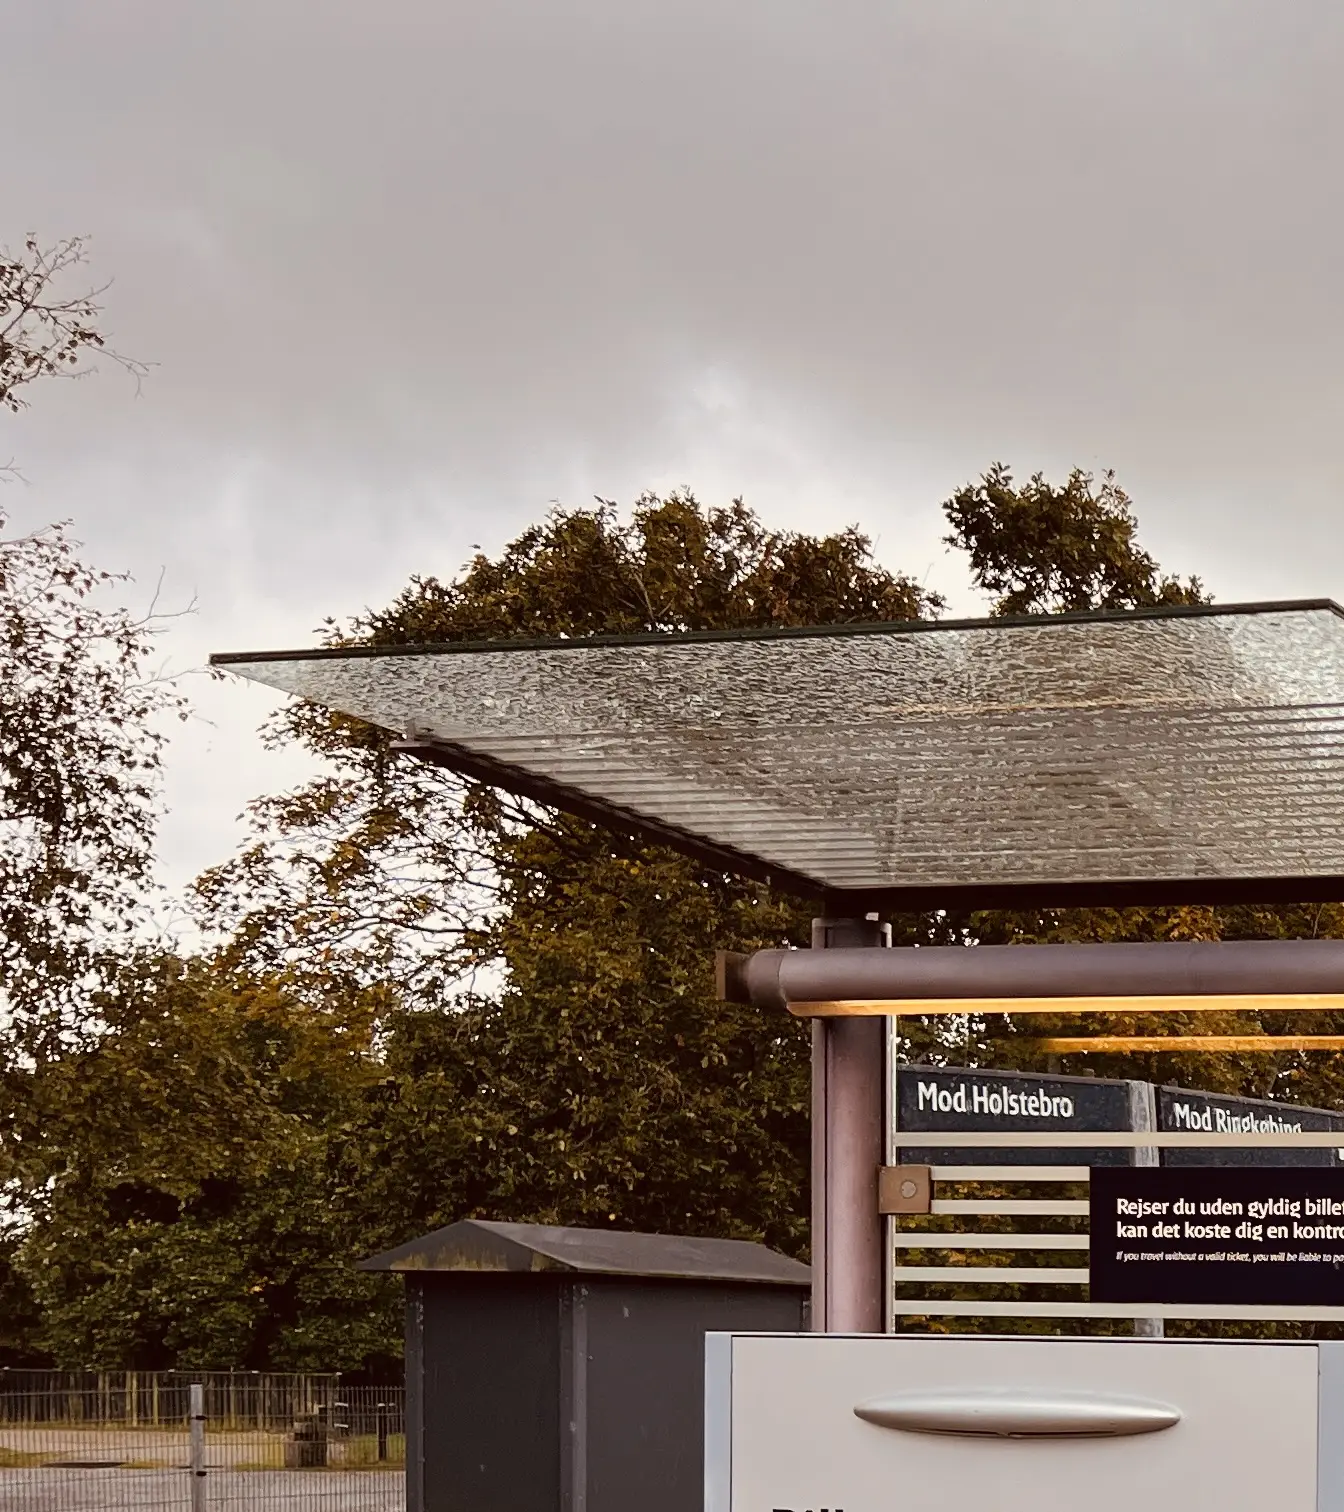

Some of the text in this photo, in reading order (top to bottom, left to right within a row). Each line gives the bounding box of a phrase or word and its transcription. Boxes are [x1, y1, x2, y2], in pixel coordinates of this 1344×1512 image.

[917, 1081, 1075, 1118] Mod Holstebro
[1173, 1102, 1212, 1131] Mod
[1116, 1198, 1169, 1218] Rejser
[1173, 1198, 1196, 1215] du
[1200, 1198, 1243, 1215] uden
[1248, 1198, 1301, 1219] gyldig
[1116, 1221, 1148, 1238] kan
[1152, 1221, 1180, 1238] det
[1184, 1221, 1231, 1238] koste
[1235, 1221, 1263, 1242] dig
[1266, 1225, 1289, 1239] en
[1124, 1252, 1139, 1262] you
[1140, 1251, 1164, 1260] travel
[1165, 1251, 1197, 1261] without
[1205, 1252, 1225, 1261] valid
[1253, 1253, 1269, 1263] you
[1270, 1252, 1285, 1262] will
[1286, 1252, 1297, 1261] be
[1322, 1253, 1332, 1262] to
